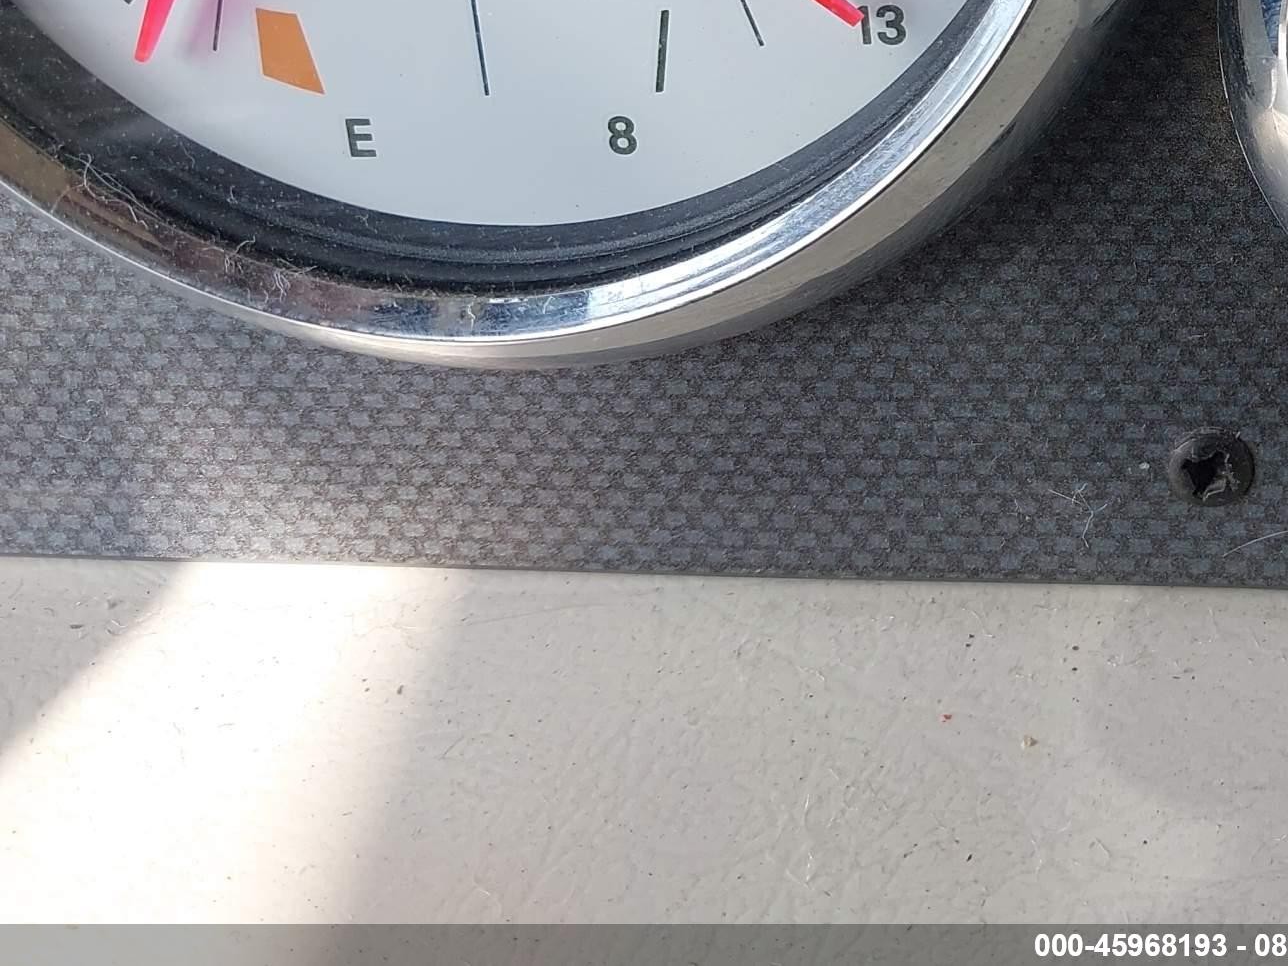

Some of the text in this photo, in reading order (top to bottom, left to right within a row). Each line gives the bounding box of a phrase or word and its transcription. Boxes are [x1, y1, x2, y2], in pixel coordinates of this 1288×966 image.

[857, 4, 907, 46] 13
[345, 118, 377, 157] E
[607, 116, 638, 154] 8
